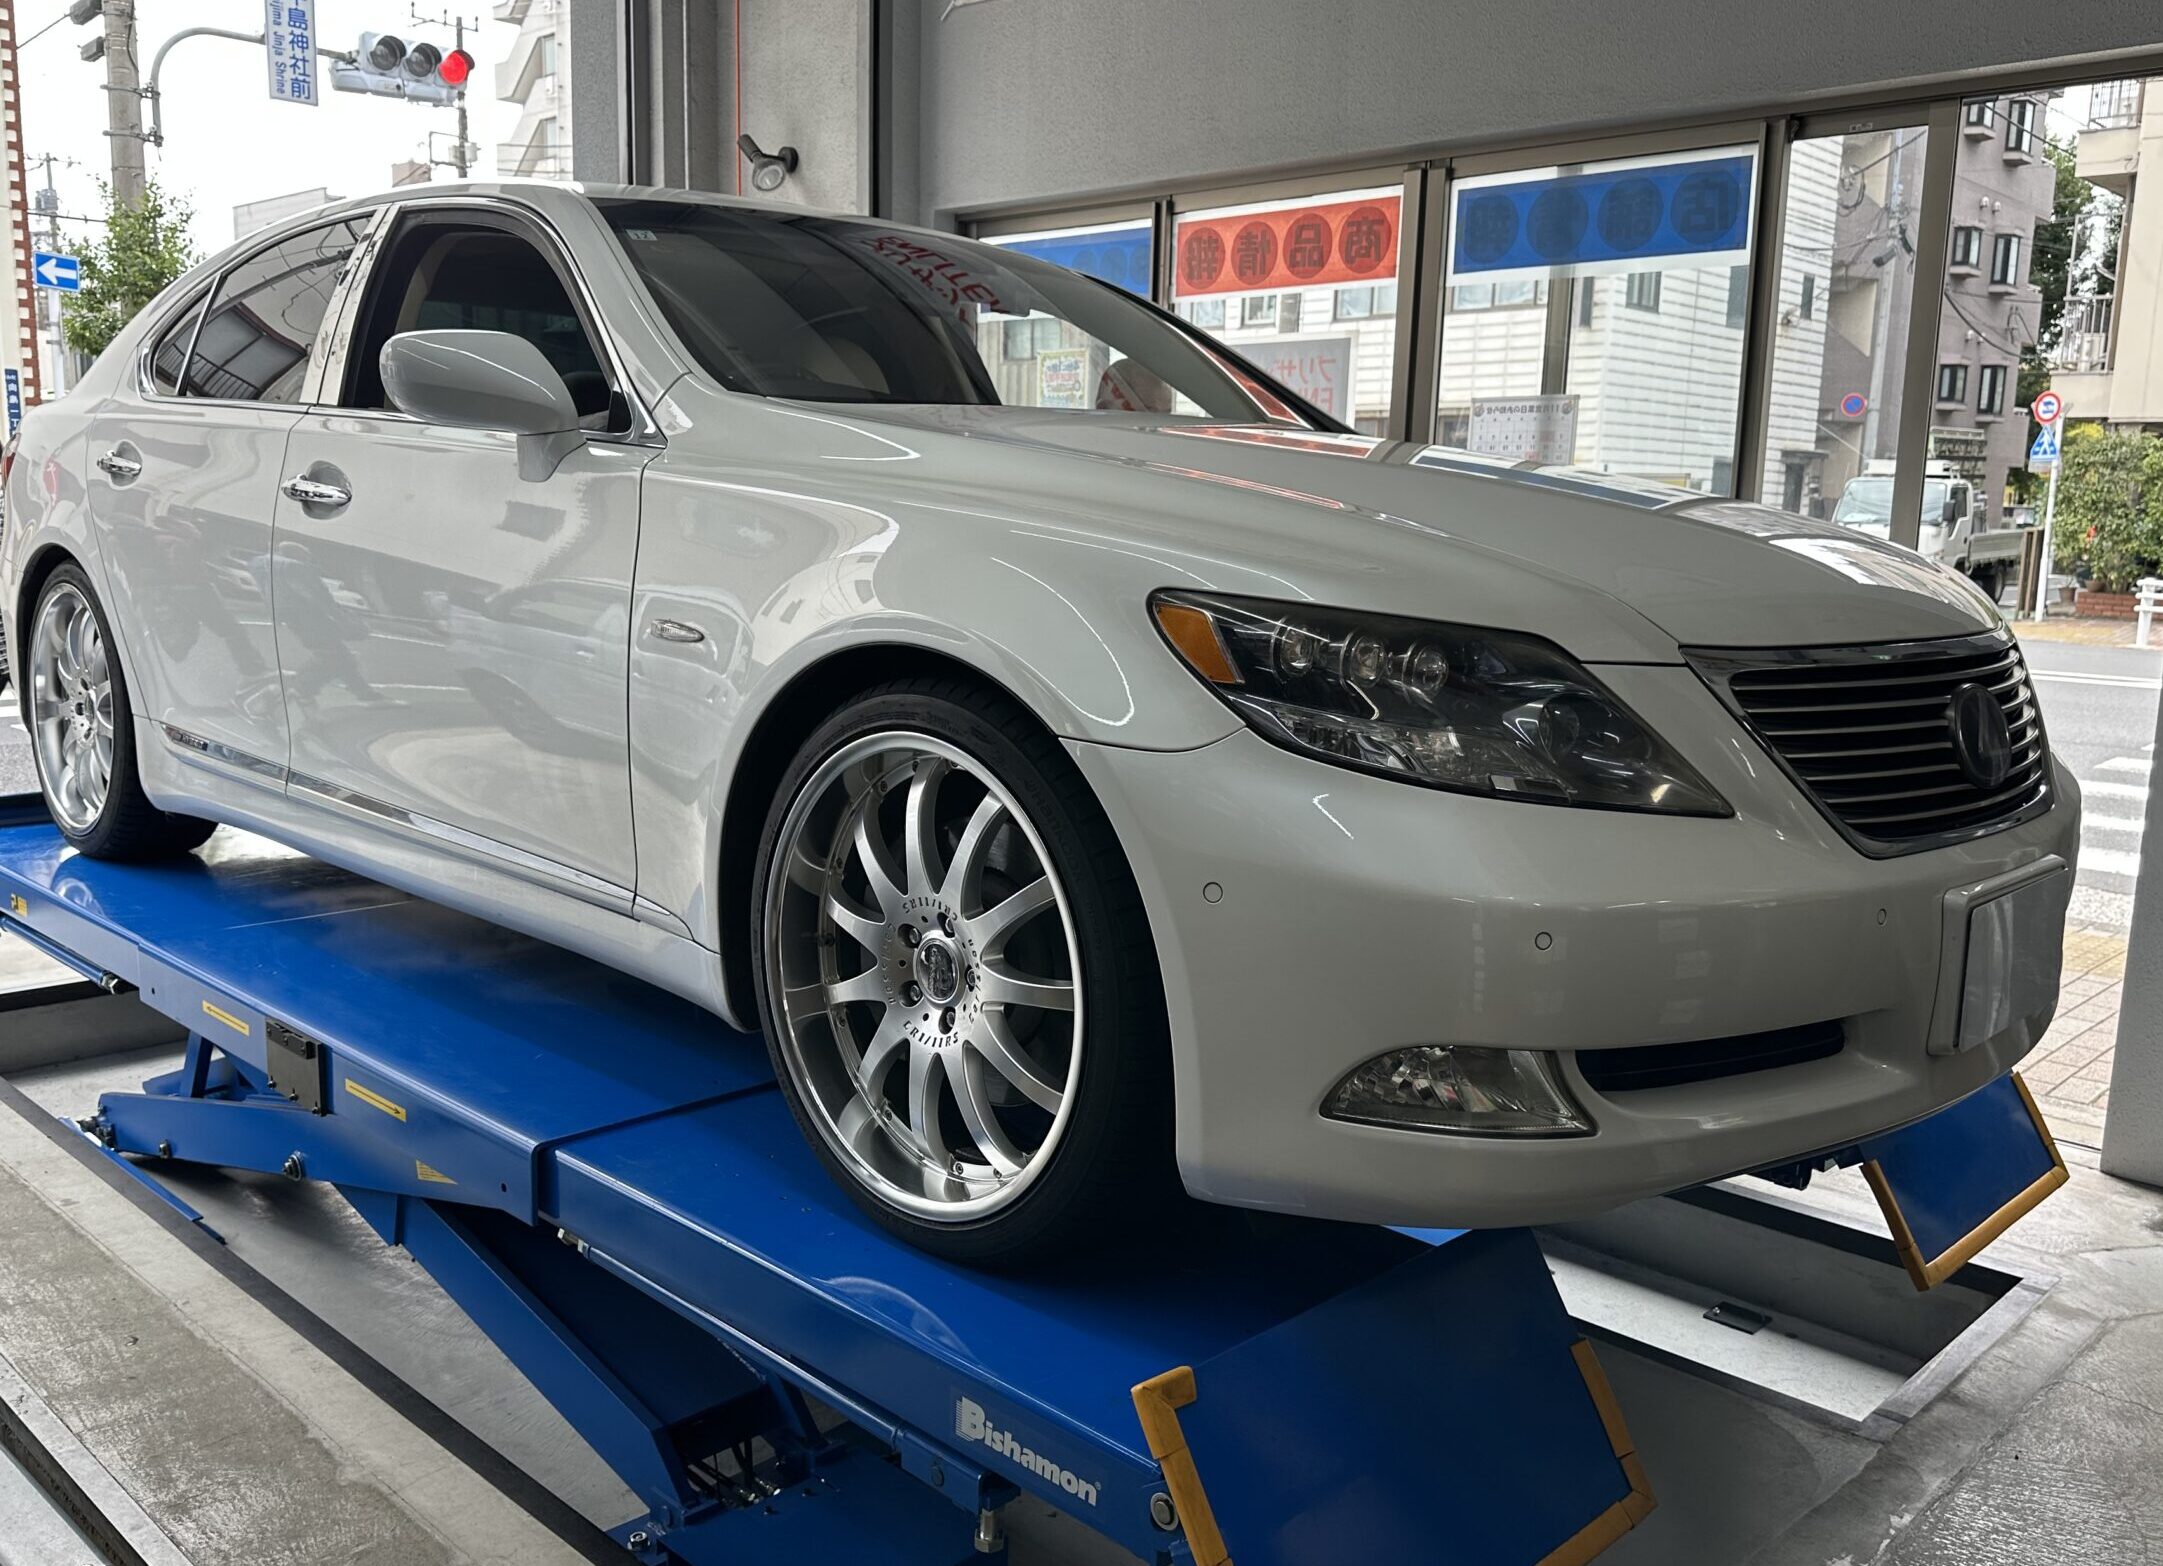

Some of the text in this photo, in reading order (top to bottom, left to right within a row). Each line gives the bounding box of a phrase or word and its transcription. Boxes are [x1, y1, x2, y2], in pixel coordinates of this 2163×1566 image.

[272, 31, 286, 56] Jinja
[288, 0, 311, 100] 島神社前
[275, 61, 287, 95] Shrine
[955, 1396, 1098, 1507] Bishamon
